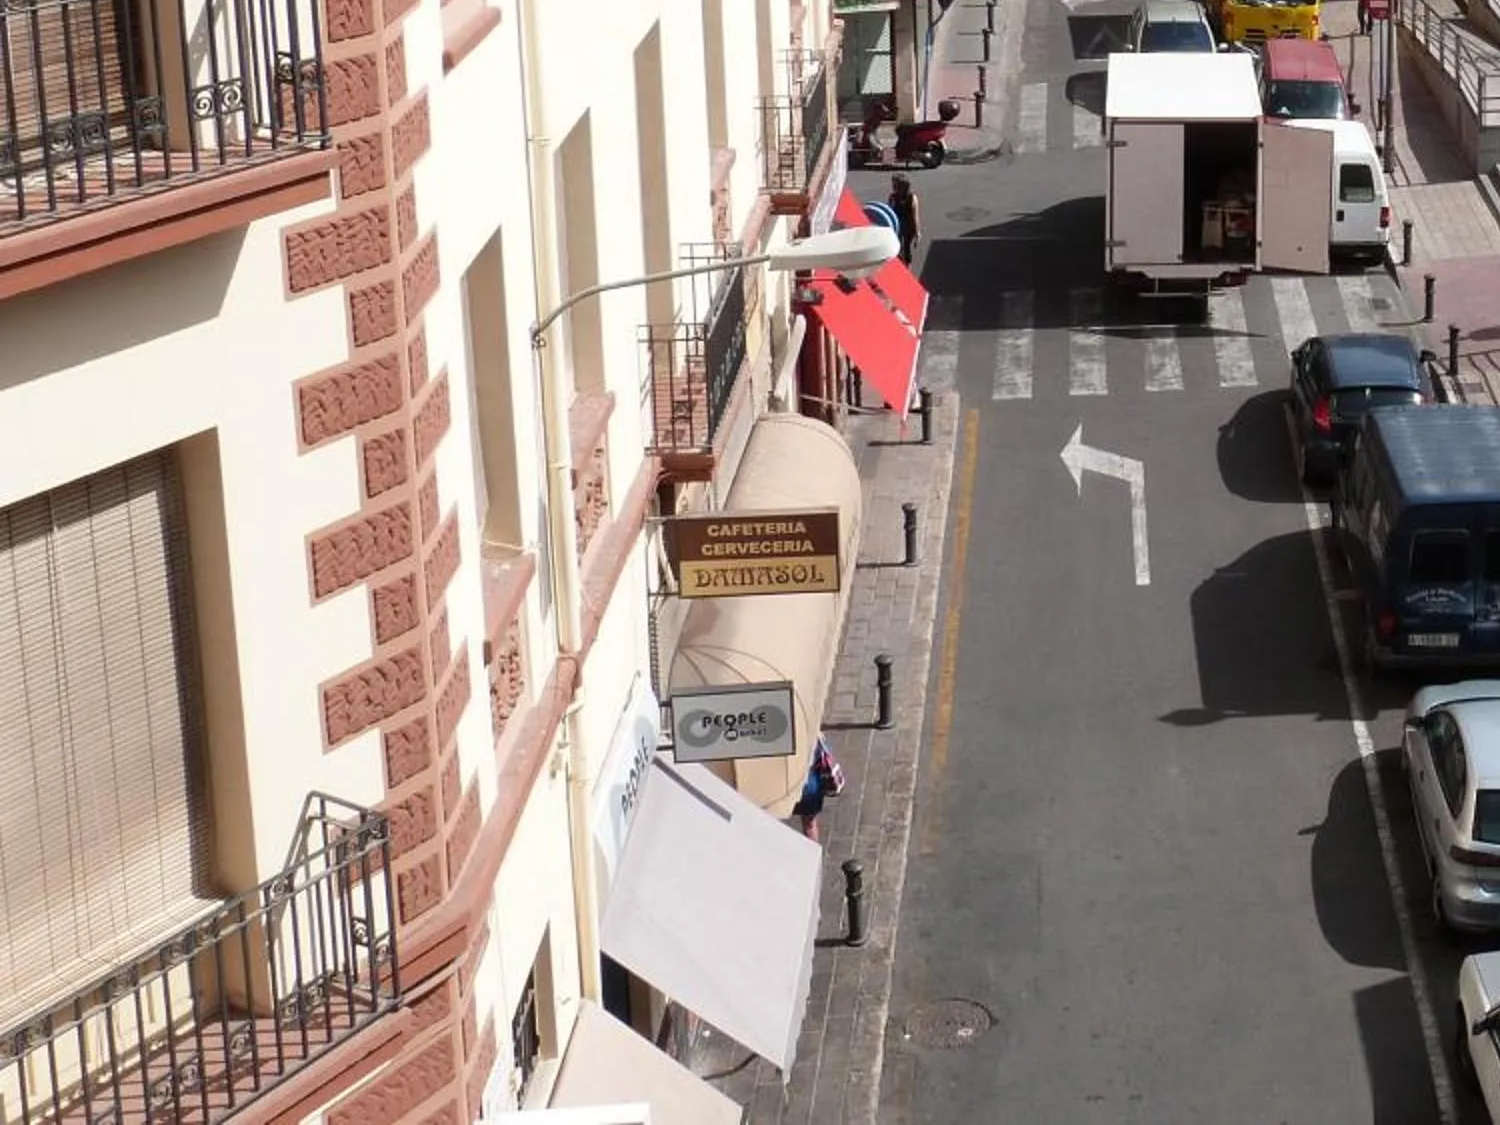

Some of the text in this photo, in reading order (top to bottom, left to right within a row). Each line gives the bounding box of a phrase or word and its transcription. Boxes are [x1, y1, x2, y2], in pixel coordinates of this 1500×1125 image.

[707, 522, 807, 537] CAFETERIA
[701, 539, 815, 556] CERVECERIA
[702, 712, 767, 729] PEOPLE
